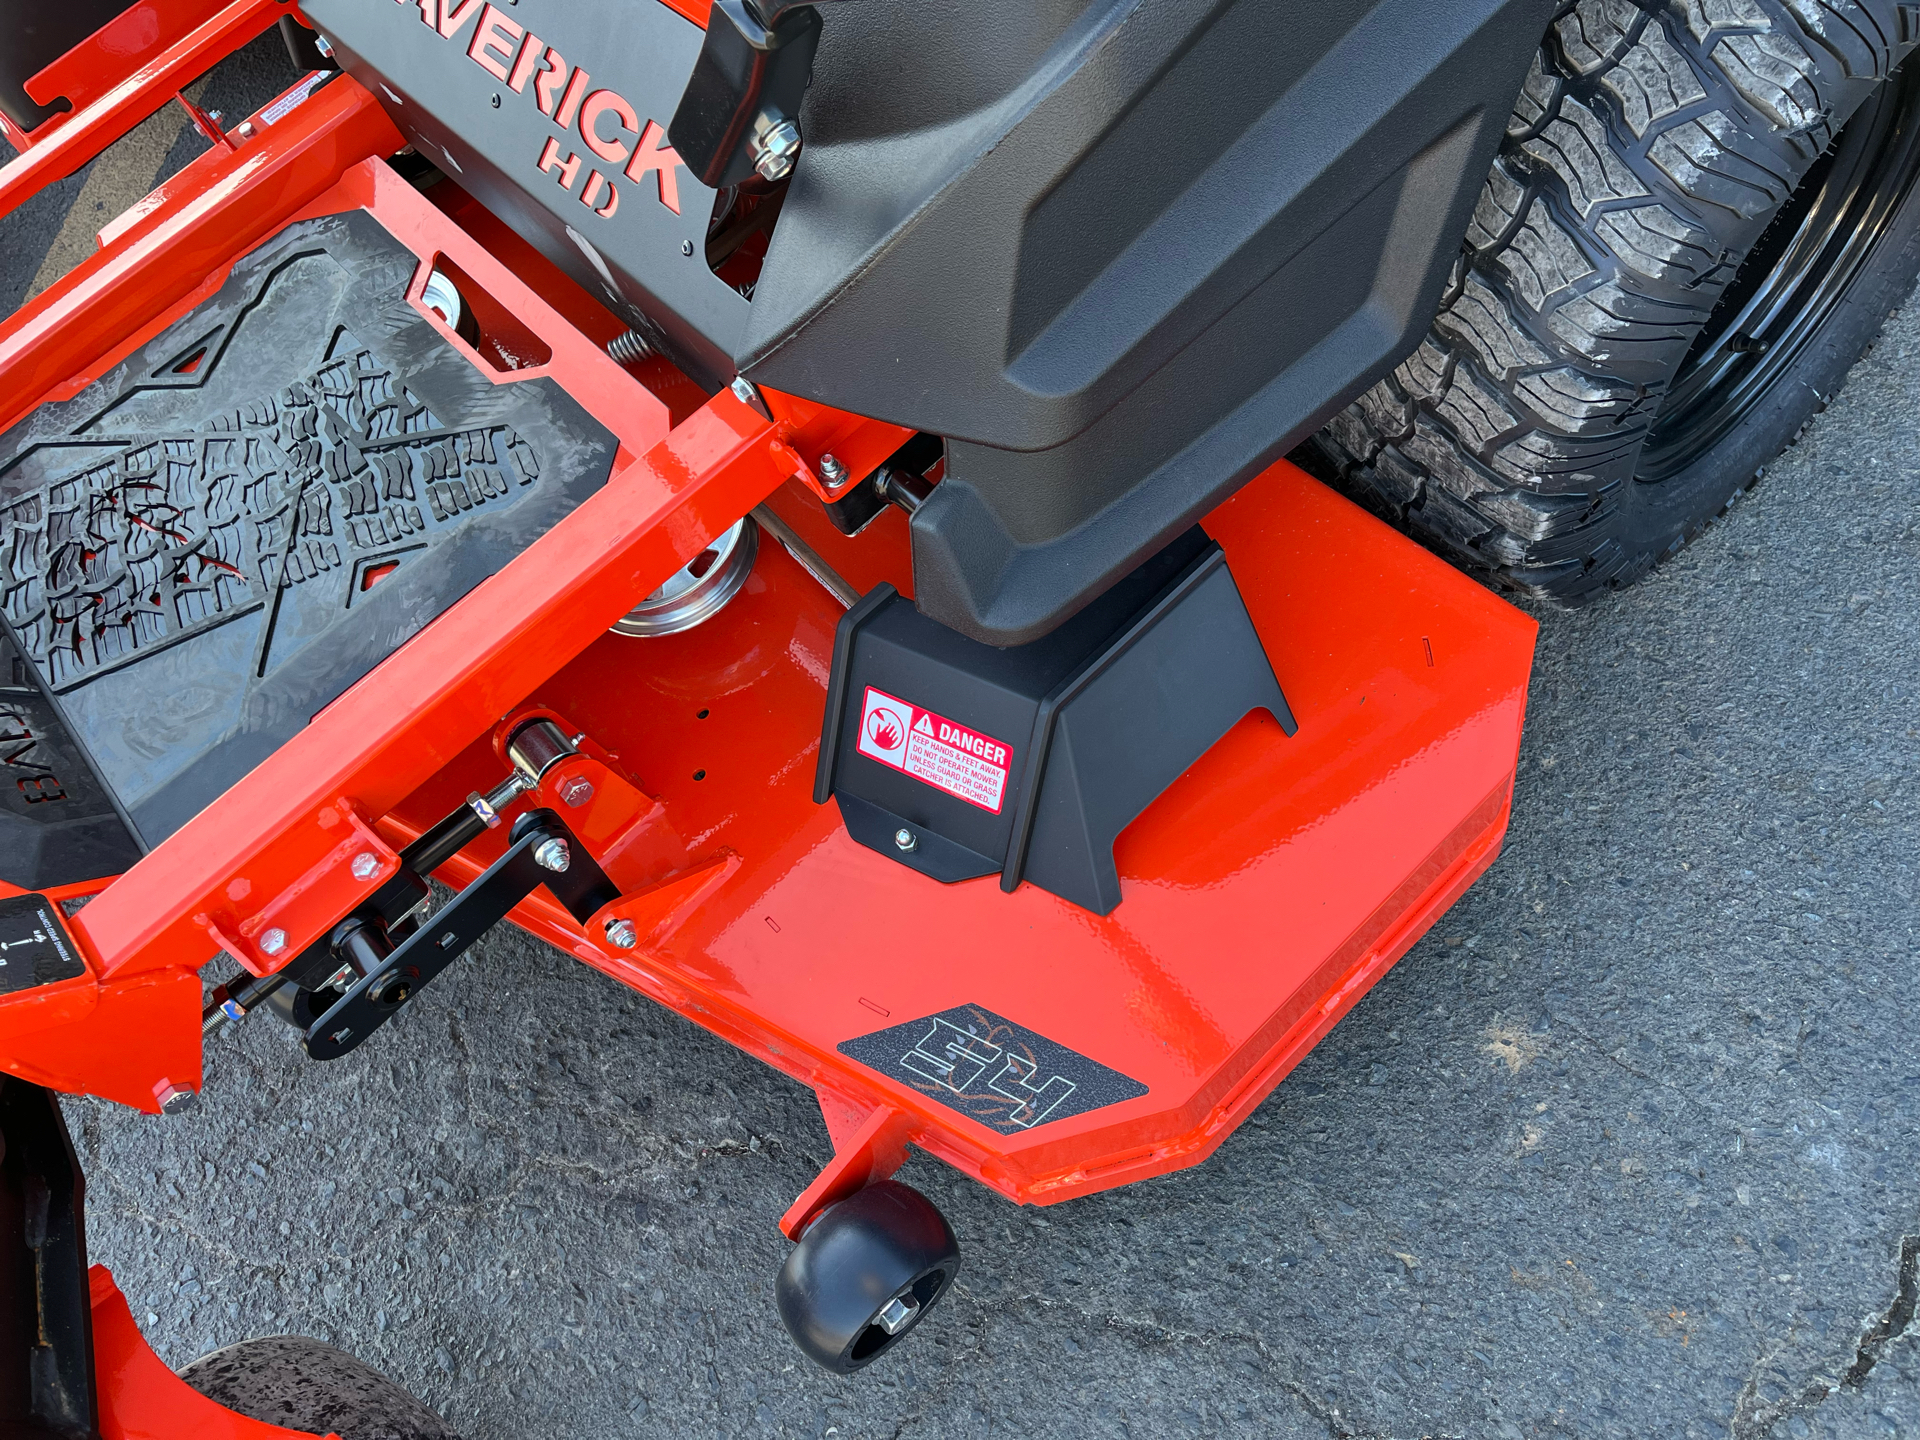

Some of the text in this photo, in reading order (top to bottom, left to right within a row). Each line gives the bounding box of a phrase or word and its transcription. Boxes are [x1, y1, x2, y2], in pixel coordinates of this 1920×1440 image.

[394, 0, 686, 216] VERICK
[536, 135, 619, 219] HD
[912, 733, 1001, 778] KEEP HANDS & FEET AWAY.
[912, 744, 998, 787] DO NOT OPERATE MOWER
[939, 722, 1006, 766] DANGER
[909, 752, 997, 797] UNLESS GUARD OR GRASS
[913, 764, 990, 805] CATCHER IS ATTACHED.
[899, 1016, 1077, 1129] 54
